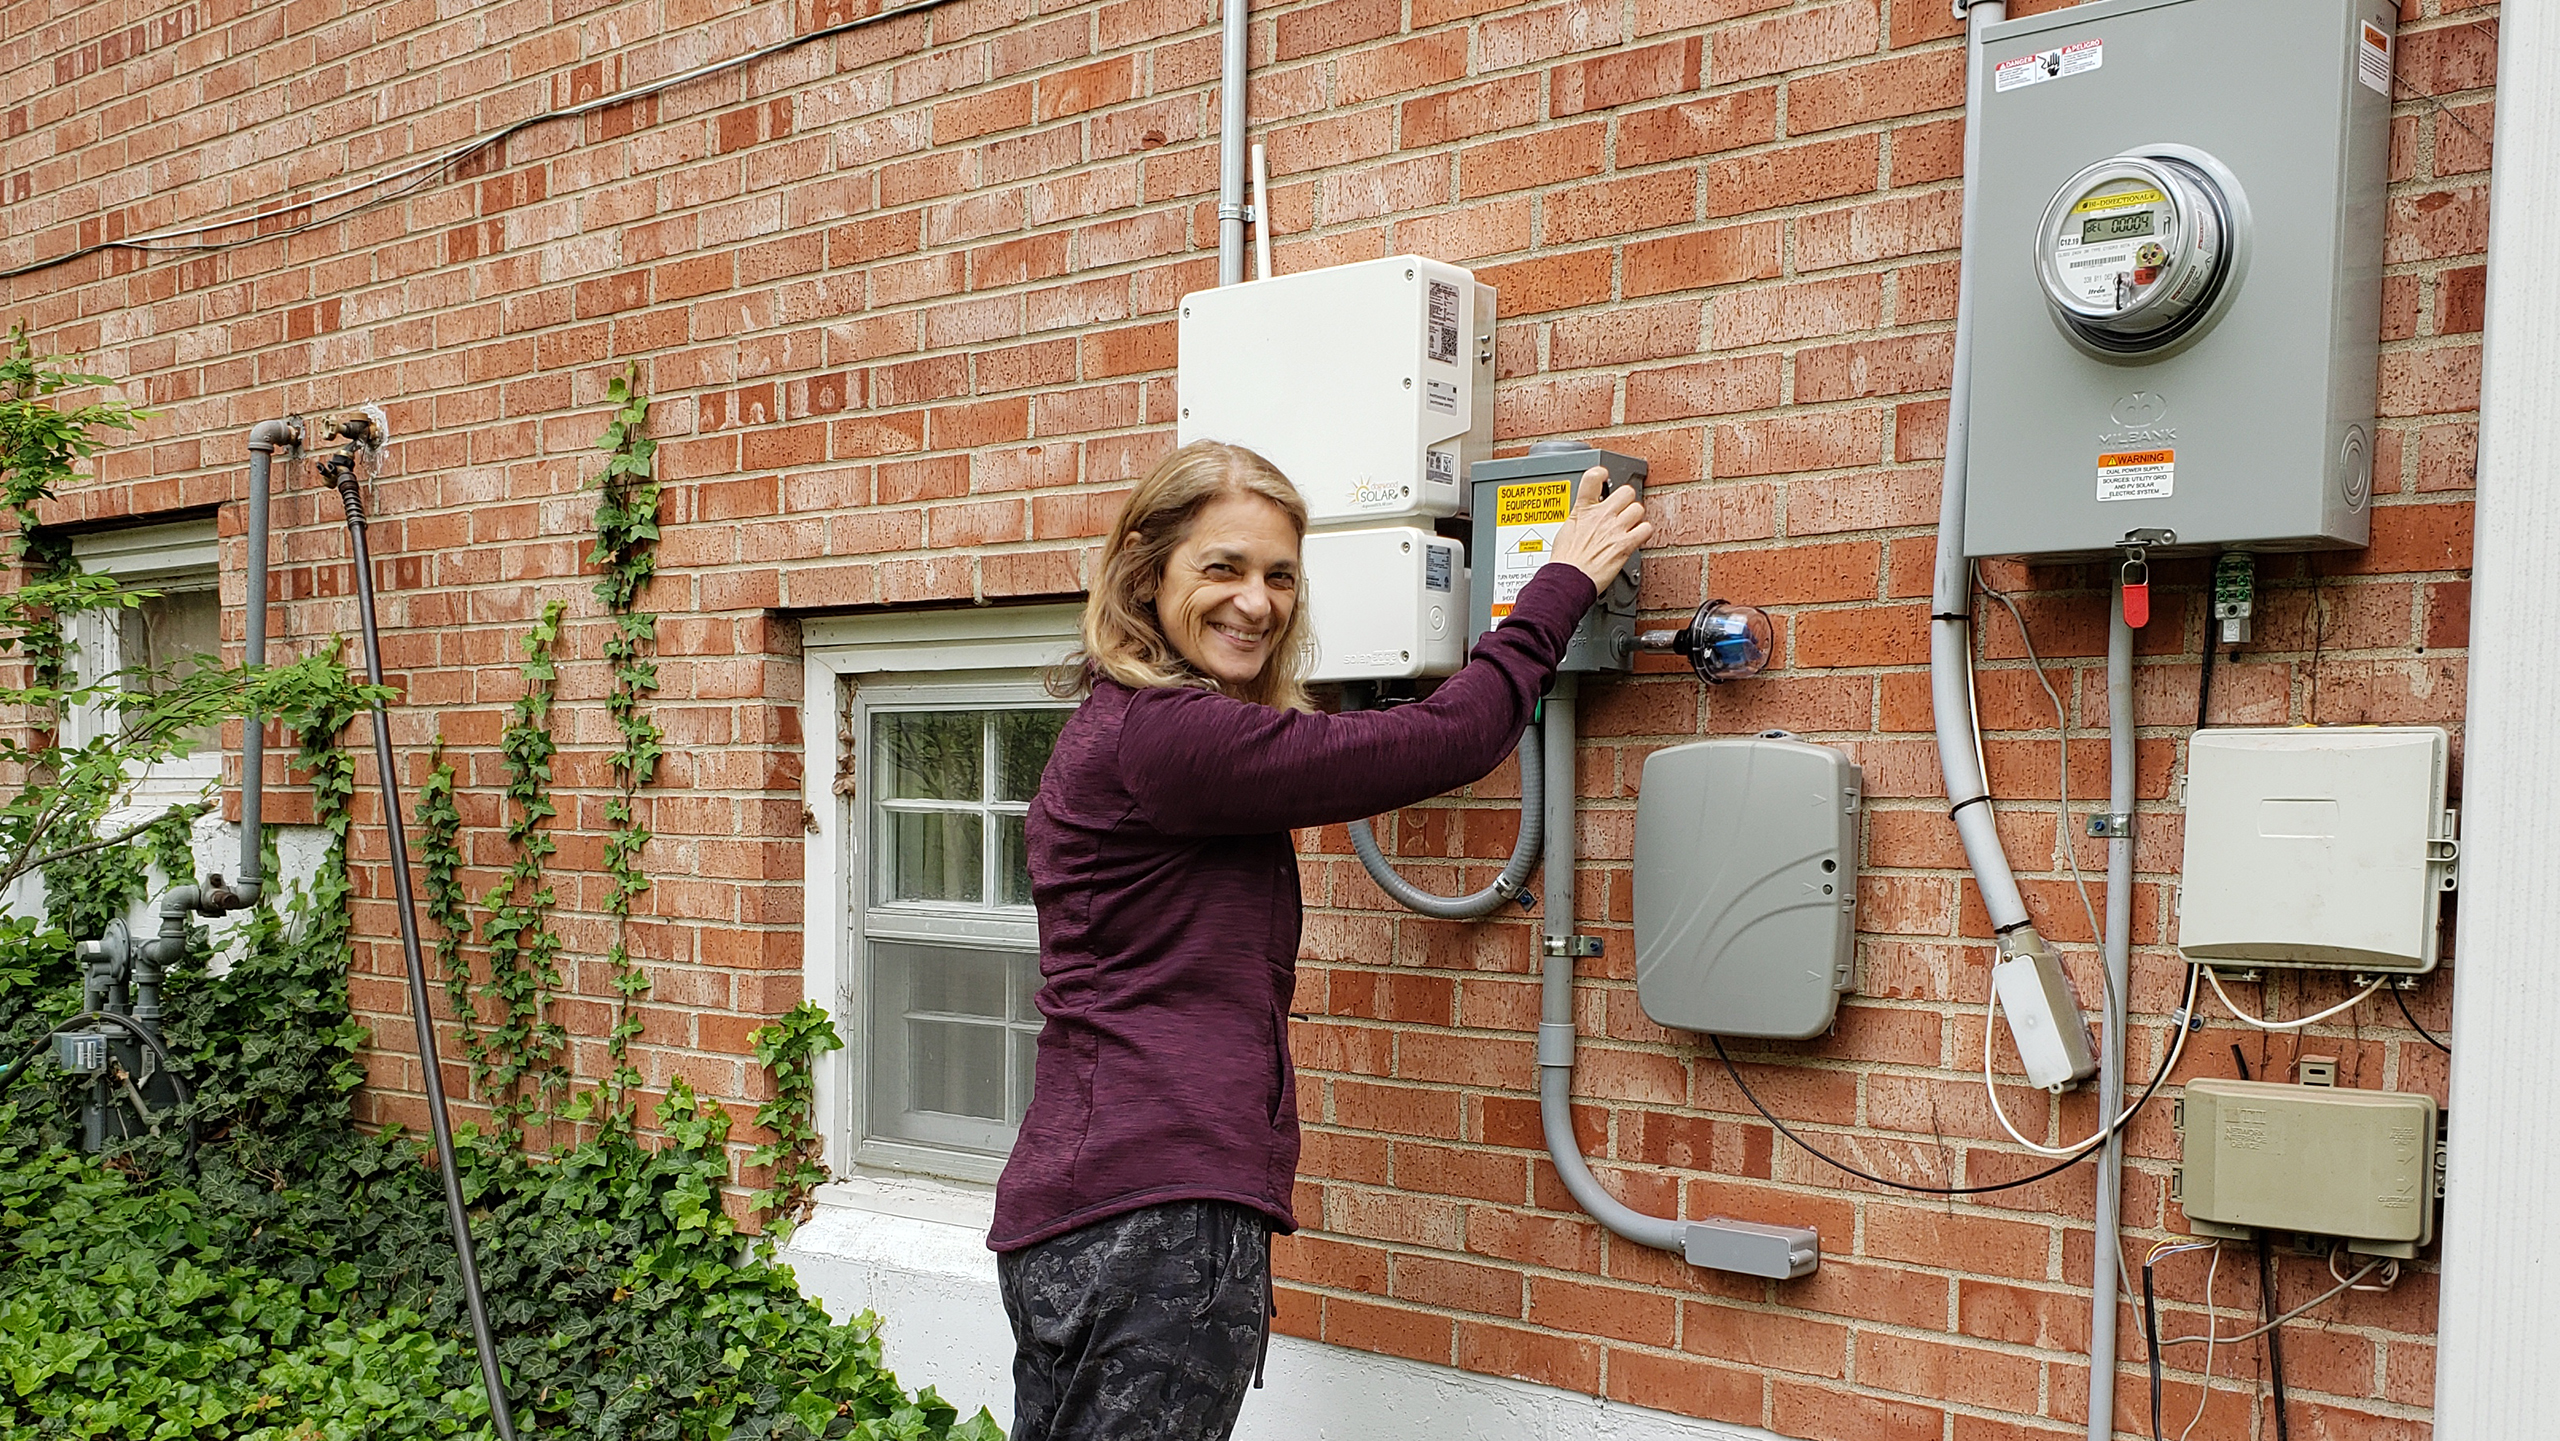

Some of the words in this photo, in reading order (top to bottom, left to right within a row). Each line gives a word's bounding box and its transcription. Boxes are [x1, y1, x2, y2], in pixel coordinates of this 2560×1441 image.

[2072, 38, 2100, 53] PELIGRO
[2006, 56, 2034, 68] DANGER
[2089, 193, 2149, 208] BI-DIRECTIONAL
[2111, 216, 2150, 234] 00004
[2098, 427, 2177, 444] MILBANK
[2117, 453, 2164, 464] WARNING
[2121, 466, 2142, 474] POWER
[1360, 488, 1397, 503] SOLAR
[1501, 487, 1525, 499] SOLAR
[1526, 486, 1537, 497] PV
[1537, 484, 1567, 496] SYSTEM
[2136, 488, 2160, 496] SYSTEM
[1505, 499, 1541, 511] EQUIPPED
[1543, 498, 1561, 508] WITH
[1500, 513, 1522, 524] RAPID
[1523, 510, 1566, 522] SHUTDOWN
[2225, 1126, 2266, 1136] NETWORK
[2224, 1133, 2268, 1144] INTERFACE
[2230, 1140, 2260, 1150] DEVICE
